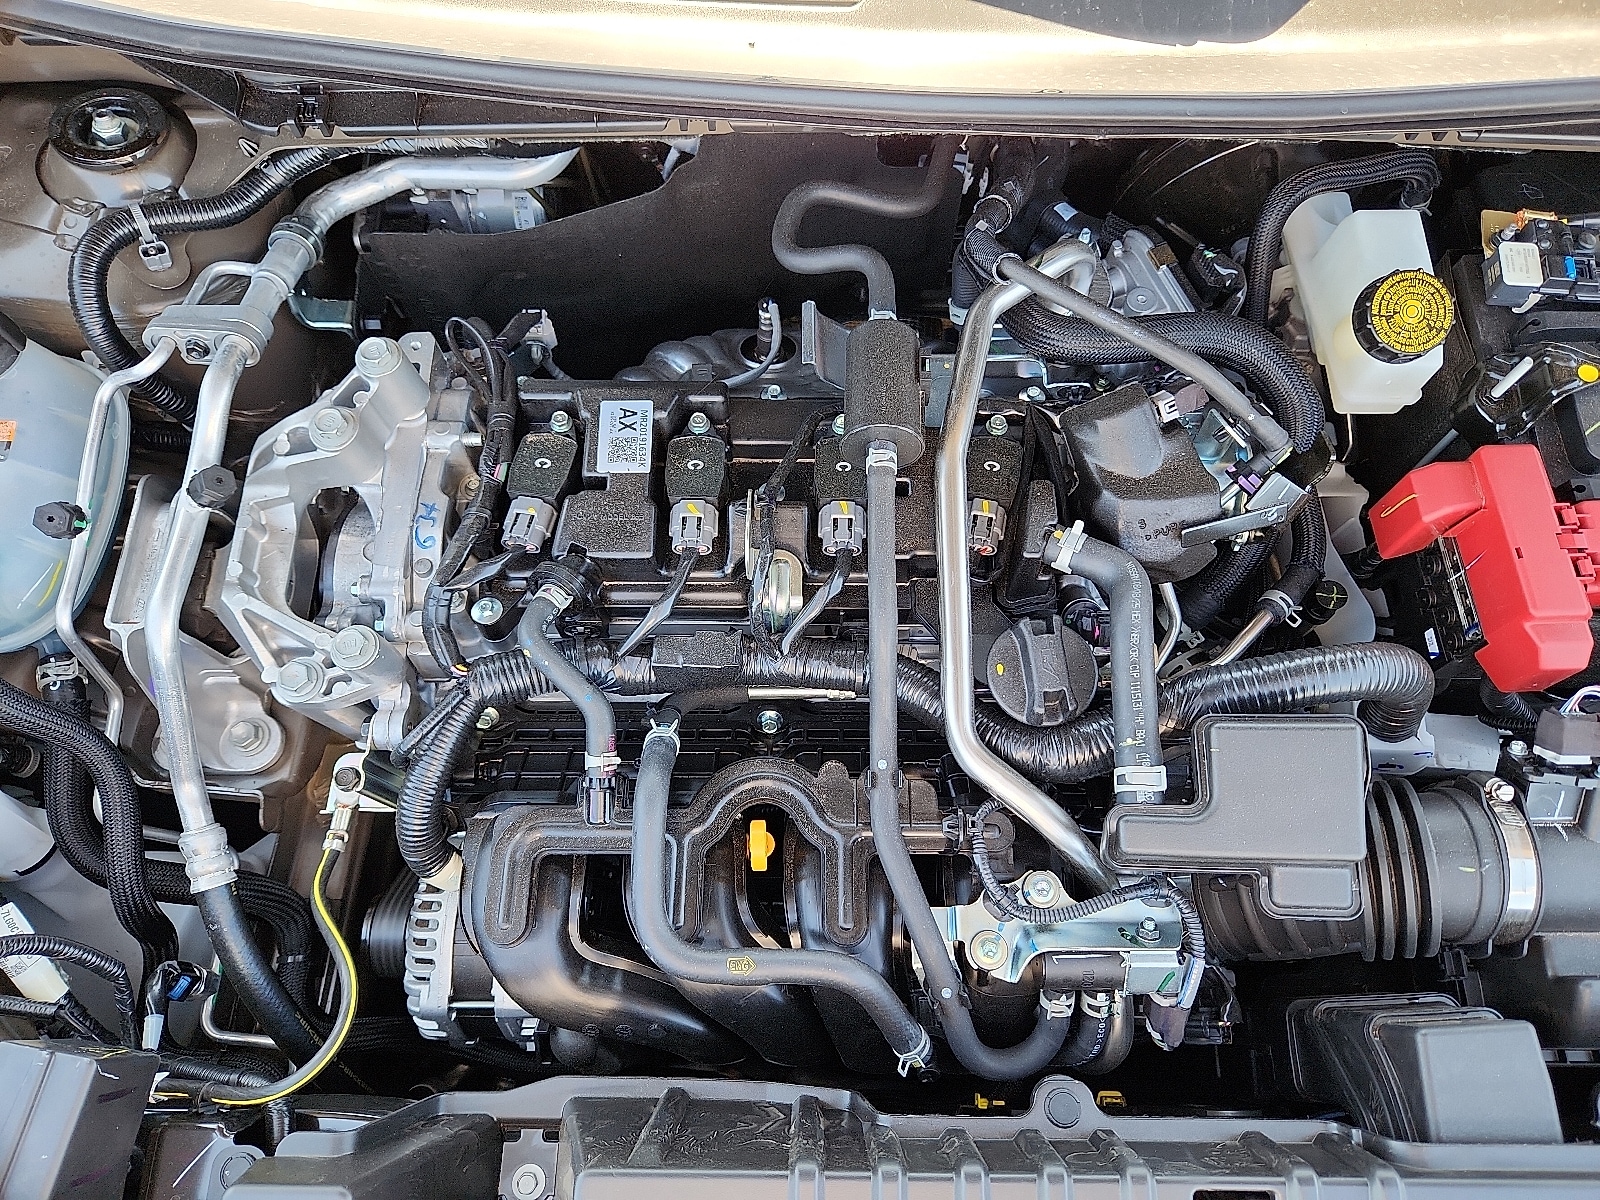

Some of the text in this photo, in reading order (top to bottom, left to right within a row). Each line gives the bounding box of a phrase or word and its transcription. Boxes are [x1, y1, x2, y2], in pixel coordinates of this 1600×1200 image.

[618, 407, 638, 432] AX
[638, 409, 649, 468] MR20191634K
[729, 960, 750, 971] ENG
